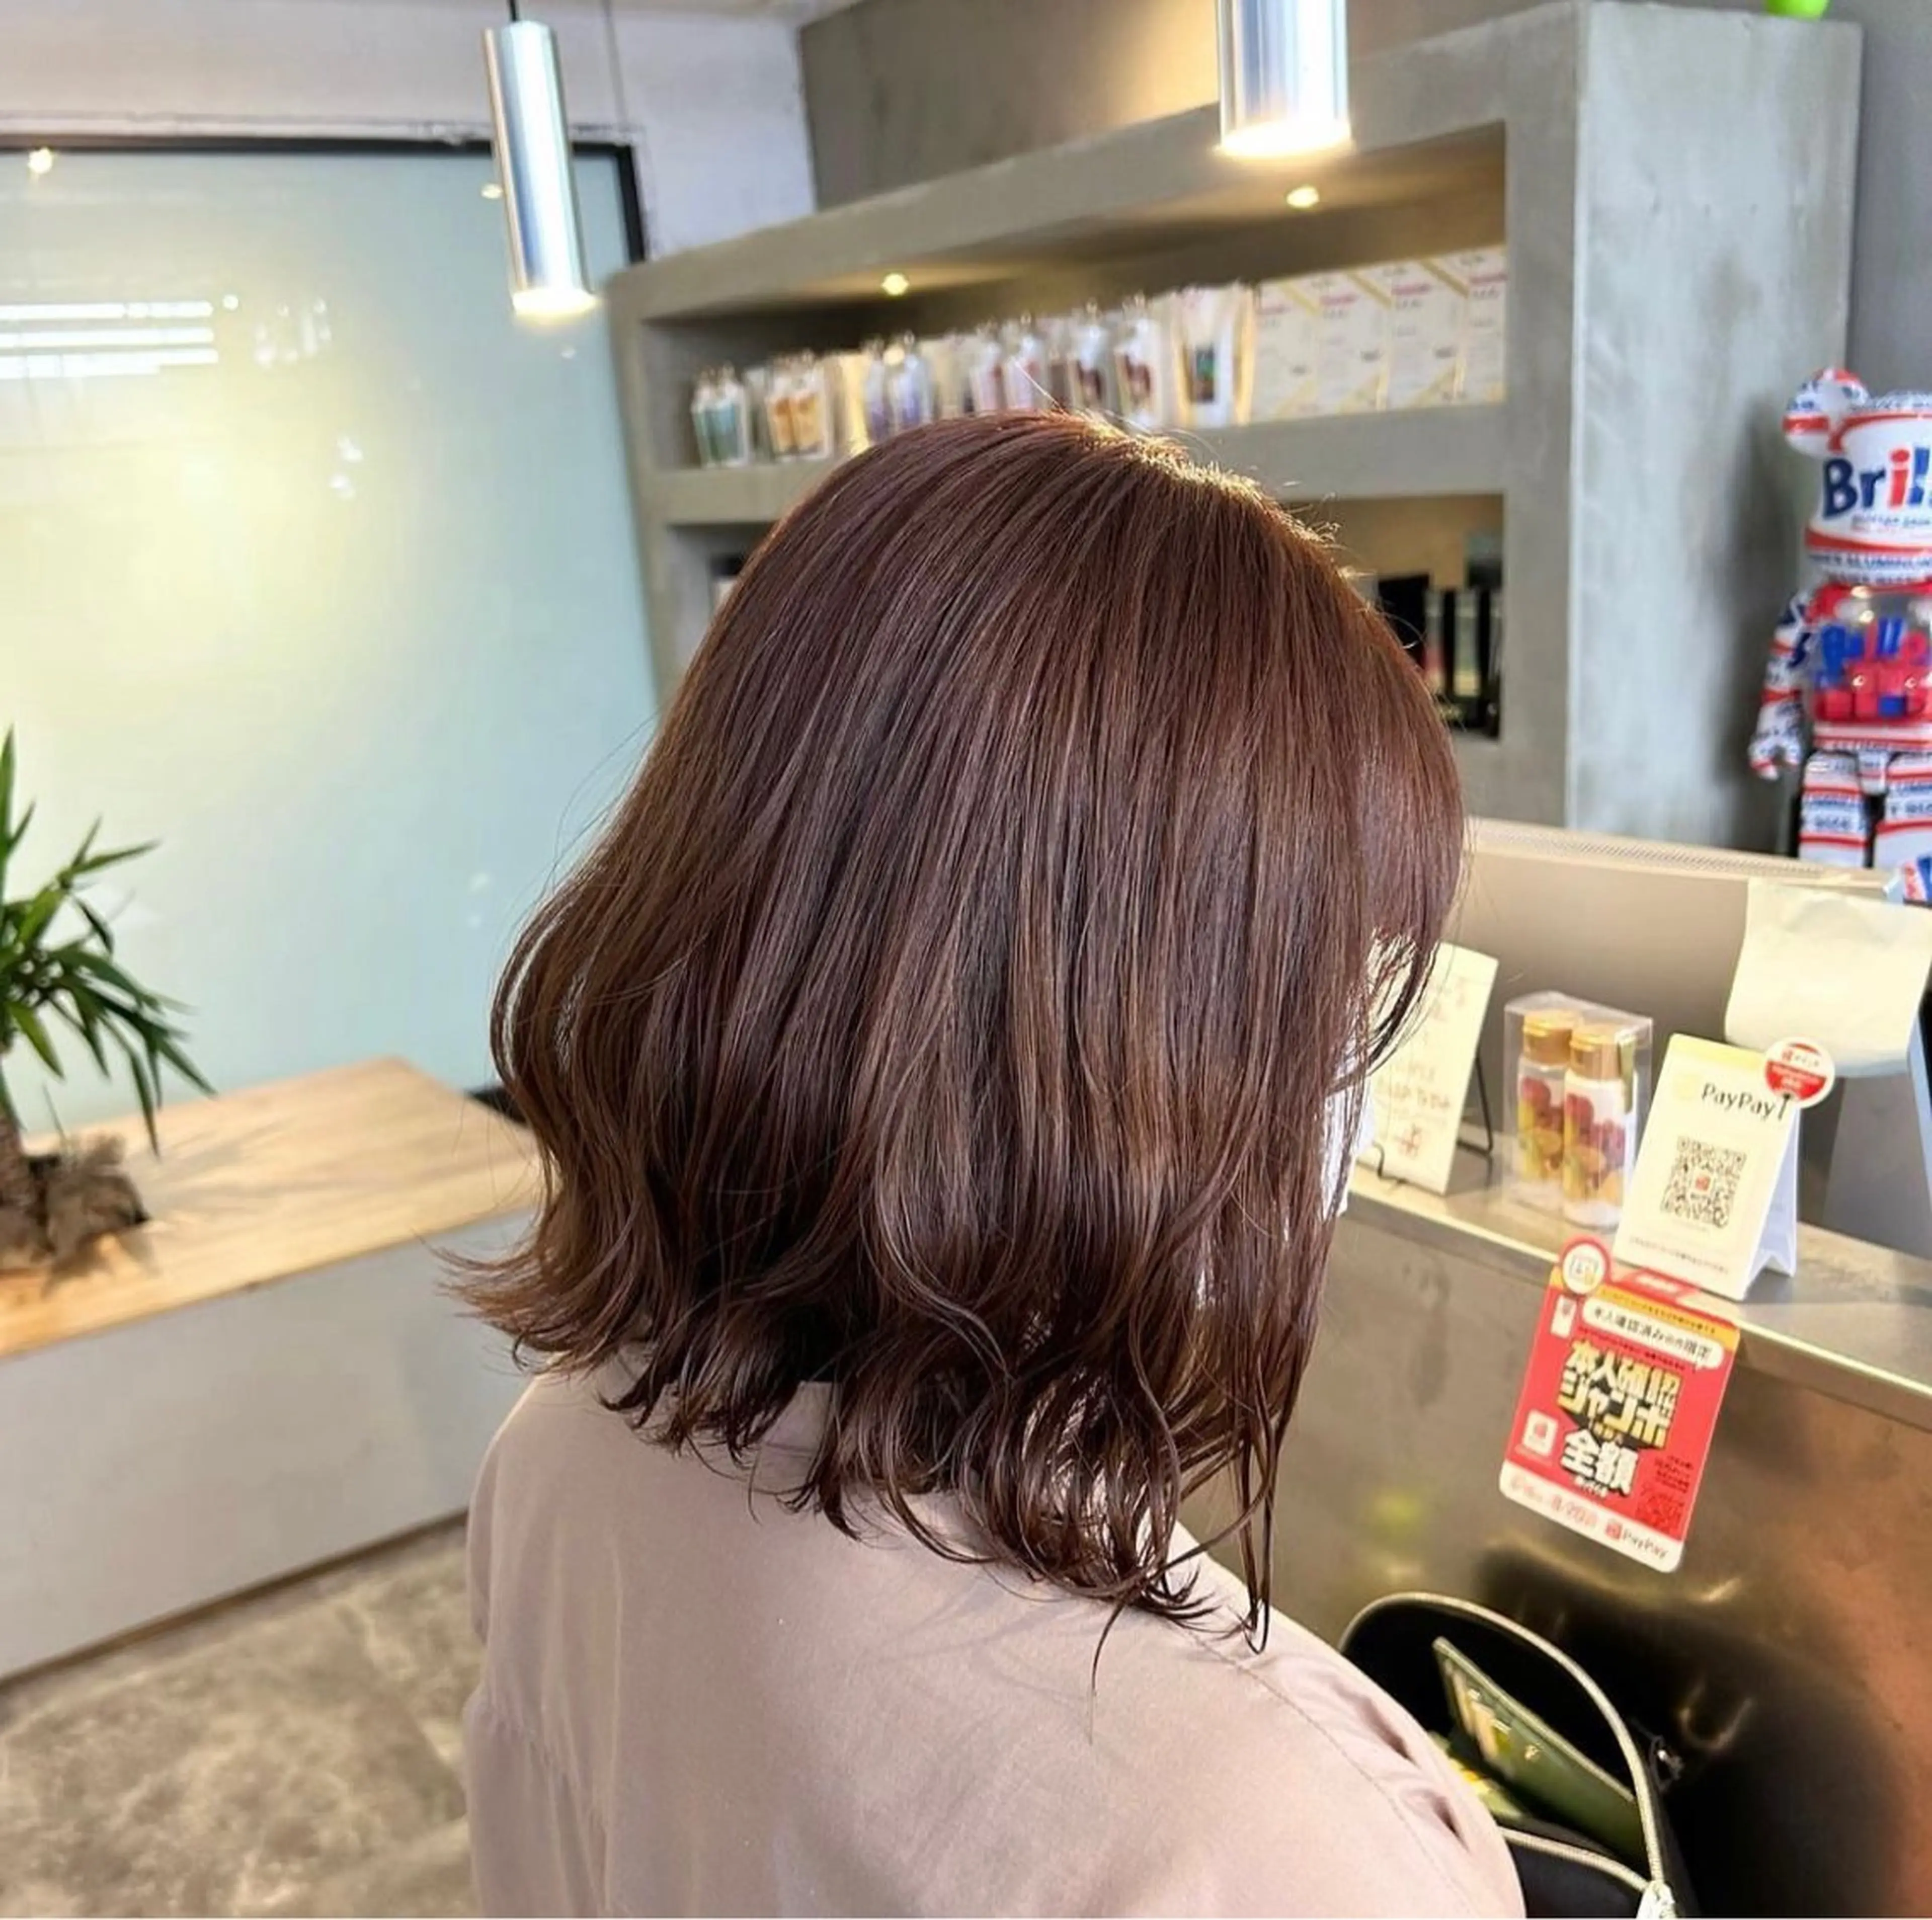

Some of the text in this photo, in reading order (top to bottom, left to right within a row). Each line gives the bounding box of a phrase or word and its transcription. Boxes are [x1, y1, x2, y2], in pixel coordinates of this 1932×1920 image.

[1823, 447, 1932, 518] Bril
[1702, 1083, 1776, 1121] PayPay
[1561, 1429, 1638, 1494] 全額
